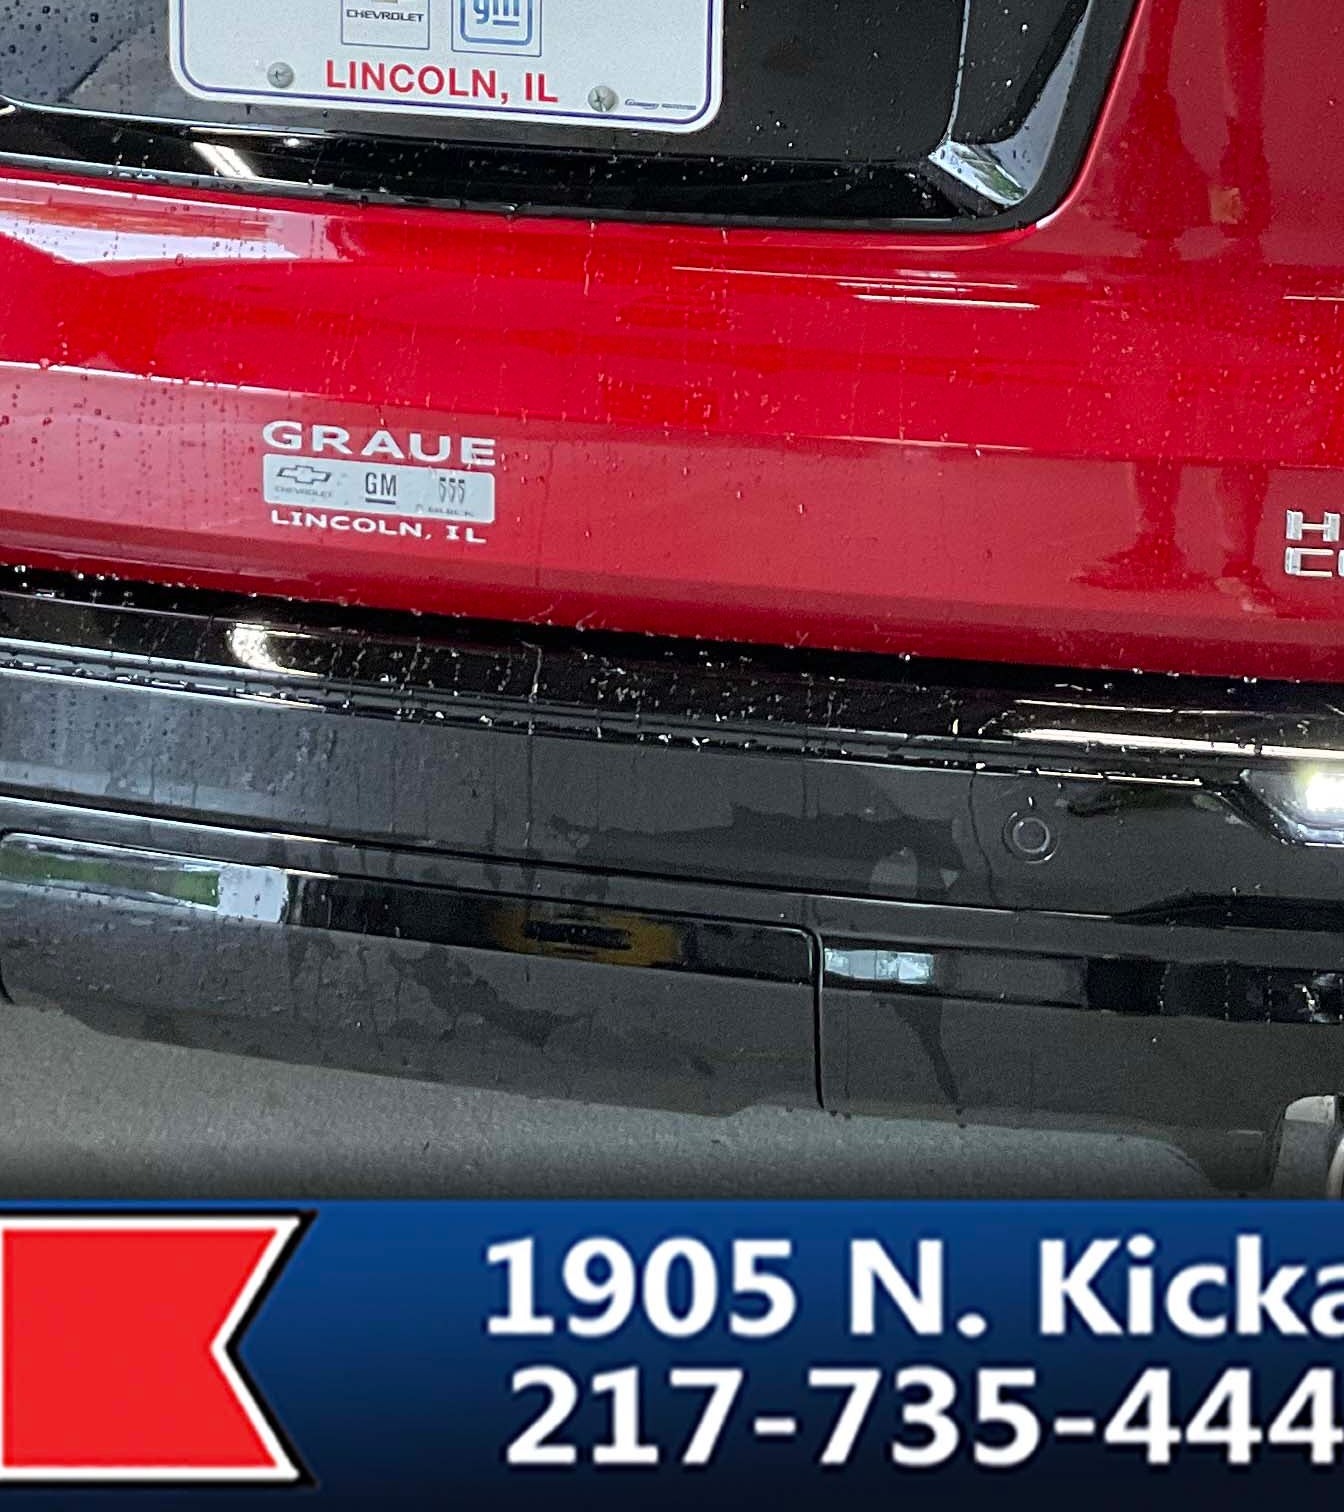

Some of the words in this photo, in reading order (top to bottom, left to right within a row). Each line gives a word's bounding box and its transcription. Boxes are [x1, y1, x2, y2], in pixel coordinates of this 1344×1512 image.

[346, 8, 425, 23] CHEVROLET
[326, 59, 509, 105] LINCOLN,
[525, 72, 559, 103] IL
[262, 419, 497, 467] GRAUE
[364, 471, 398, 498] GM
[270, 509, 433, 540] LINCOLN,
[446, 524, 488, 544] IL
